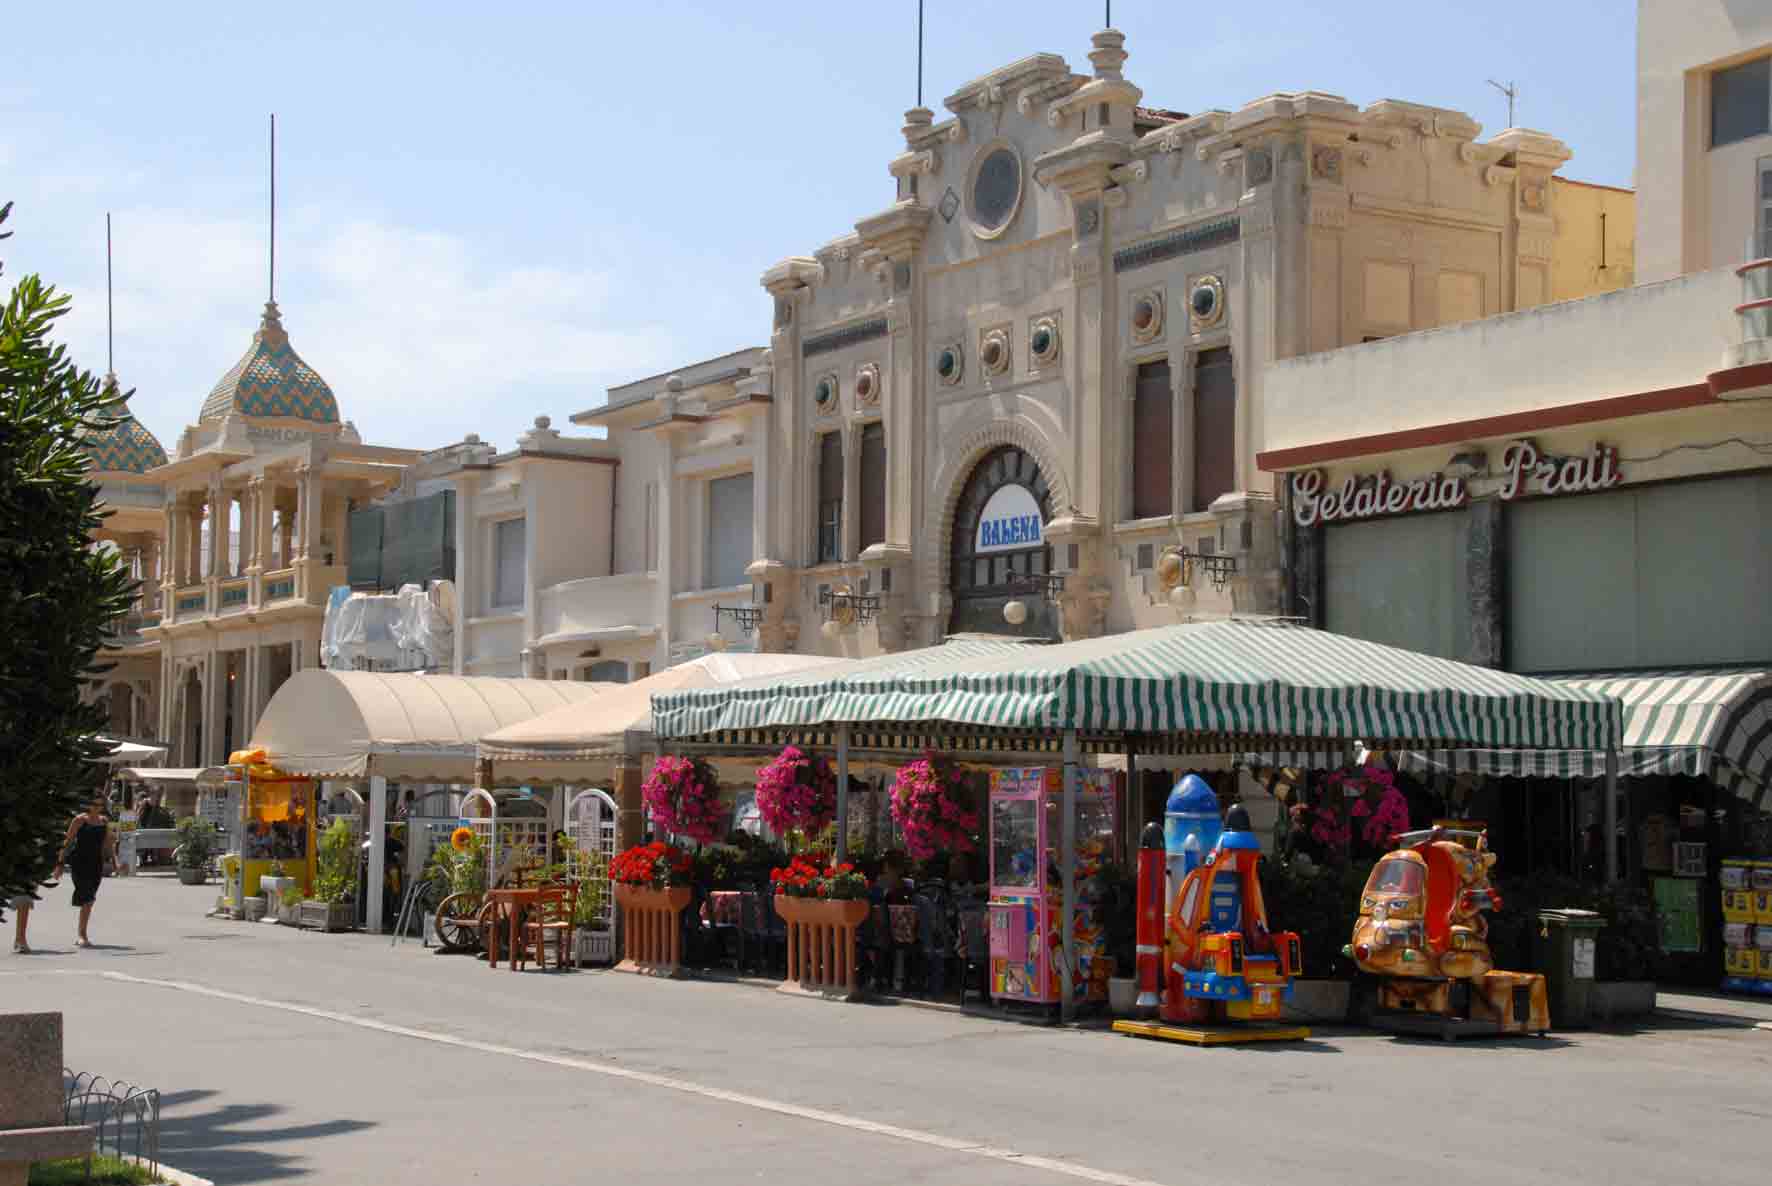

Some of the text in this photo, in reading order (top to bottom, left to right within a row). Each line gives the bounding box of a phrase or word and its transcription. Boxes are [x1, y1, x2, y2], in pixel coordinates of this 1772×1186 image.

[1293, 440, 1617, 527] Gelateria Prati
[981, 514, 1041, 546] BALENA
